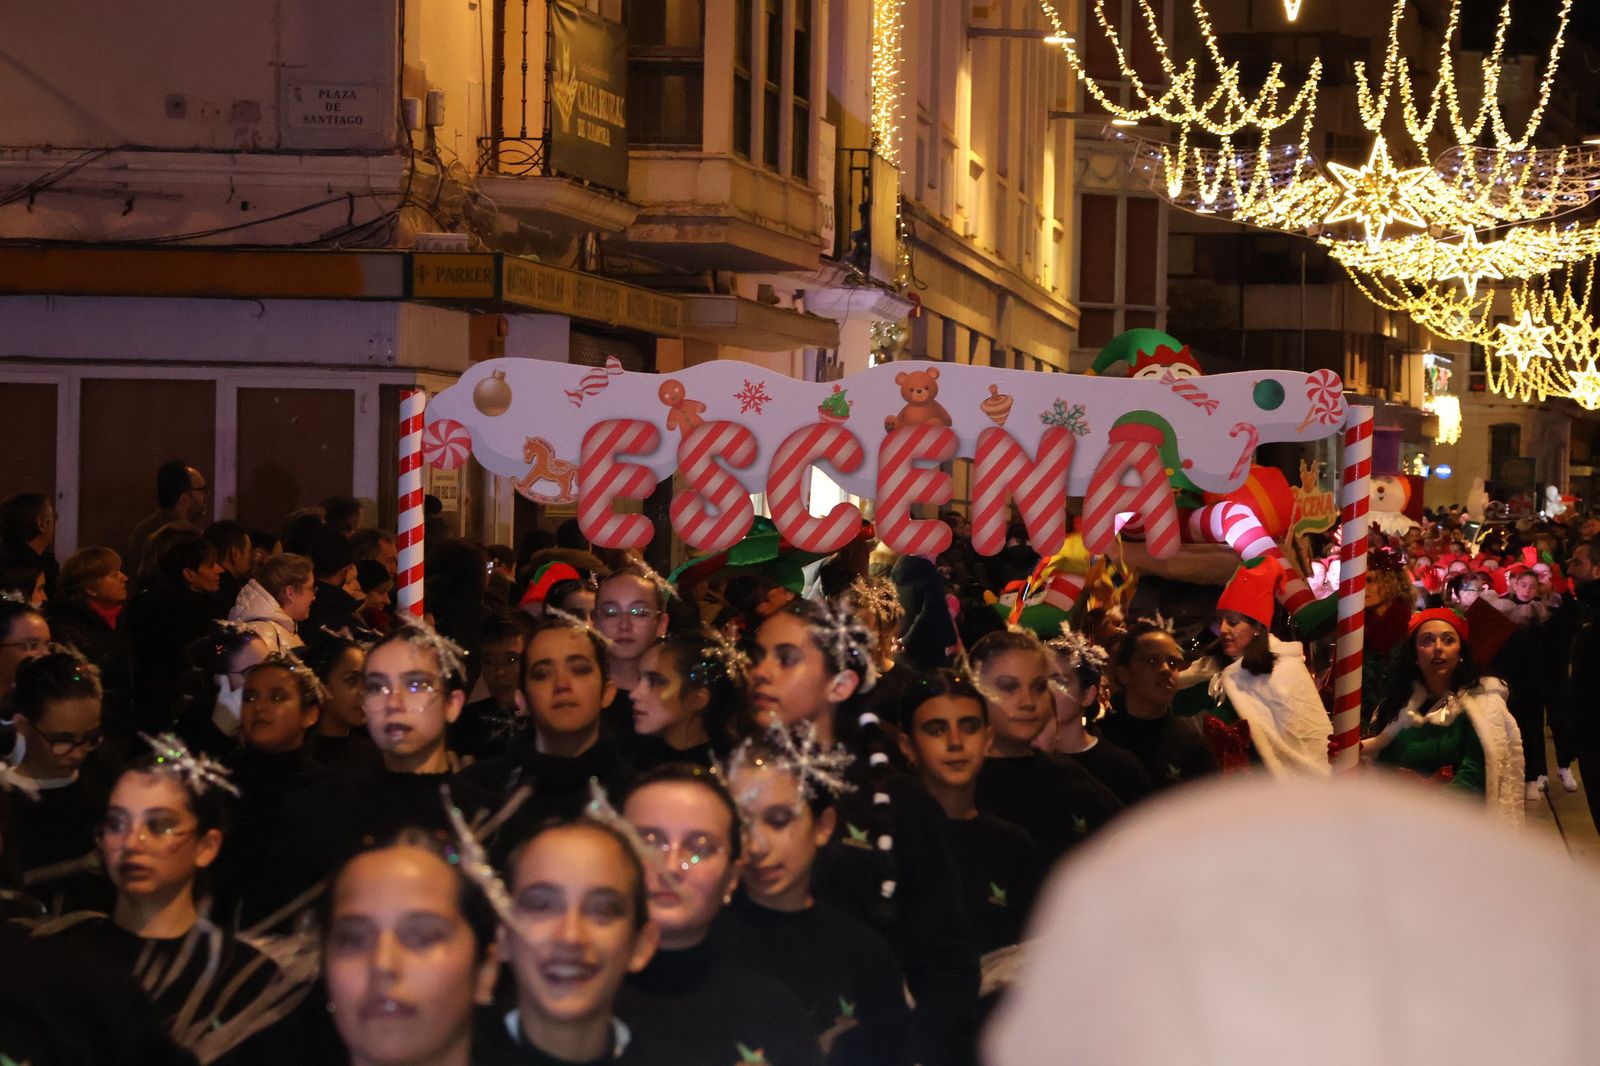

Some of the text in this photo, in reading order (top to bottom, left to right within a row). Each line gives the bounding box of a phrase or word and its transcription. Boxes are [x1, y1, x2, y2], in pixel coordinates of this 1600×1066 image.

[318, 89, 357, 100] PLAZA
[325, 102, 342, 112] DE
[303, 114, 363, 125] SANTIAGO
[436, 266, 493, 283] PARKER
[577, 418, 1182, 560] ESCENA
